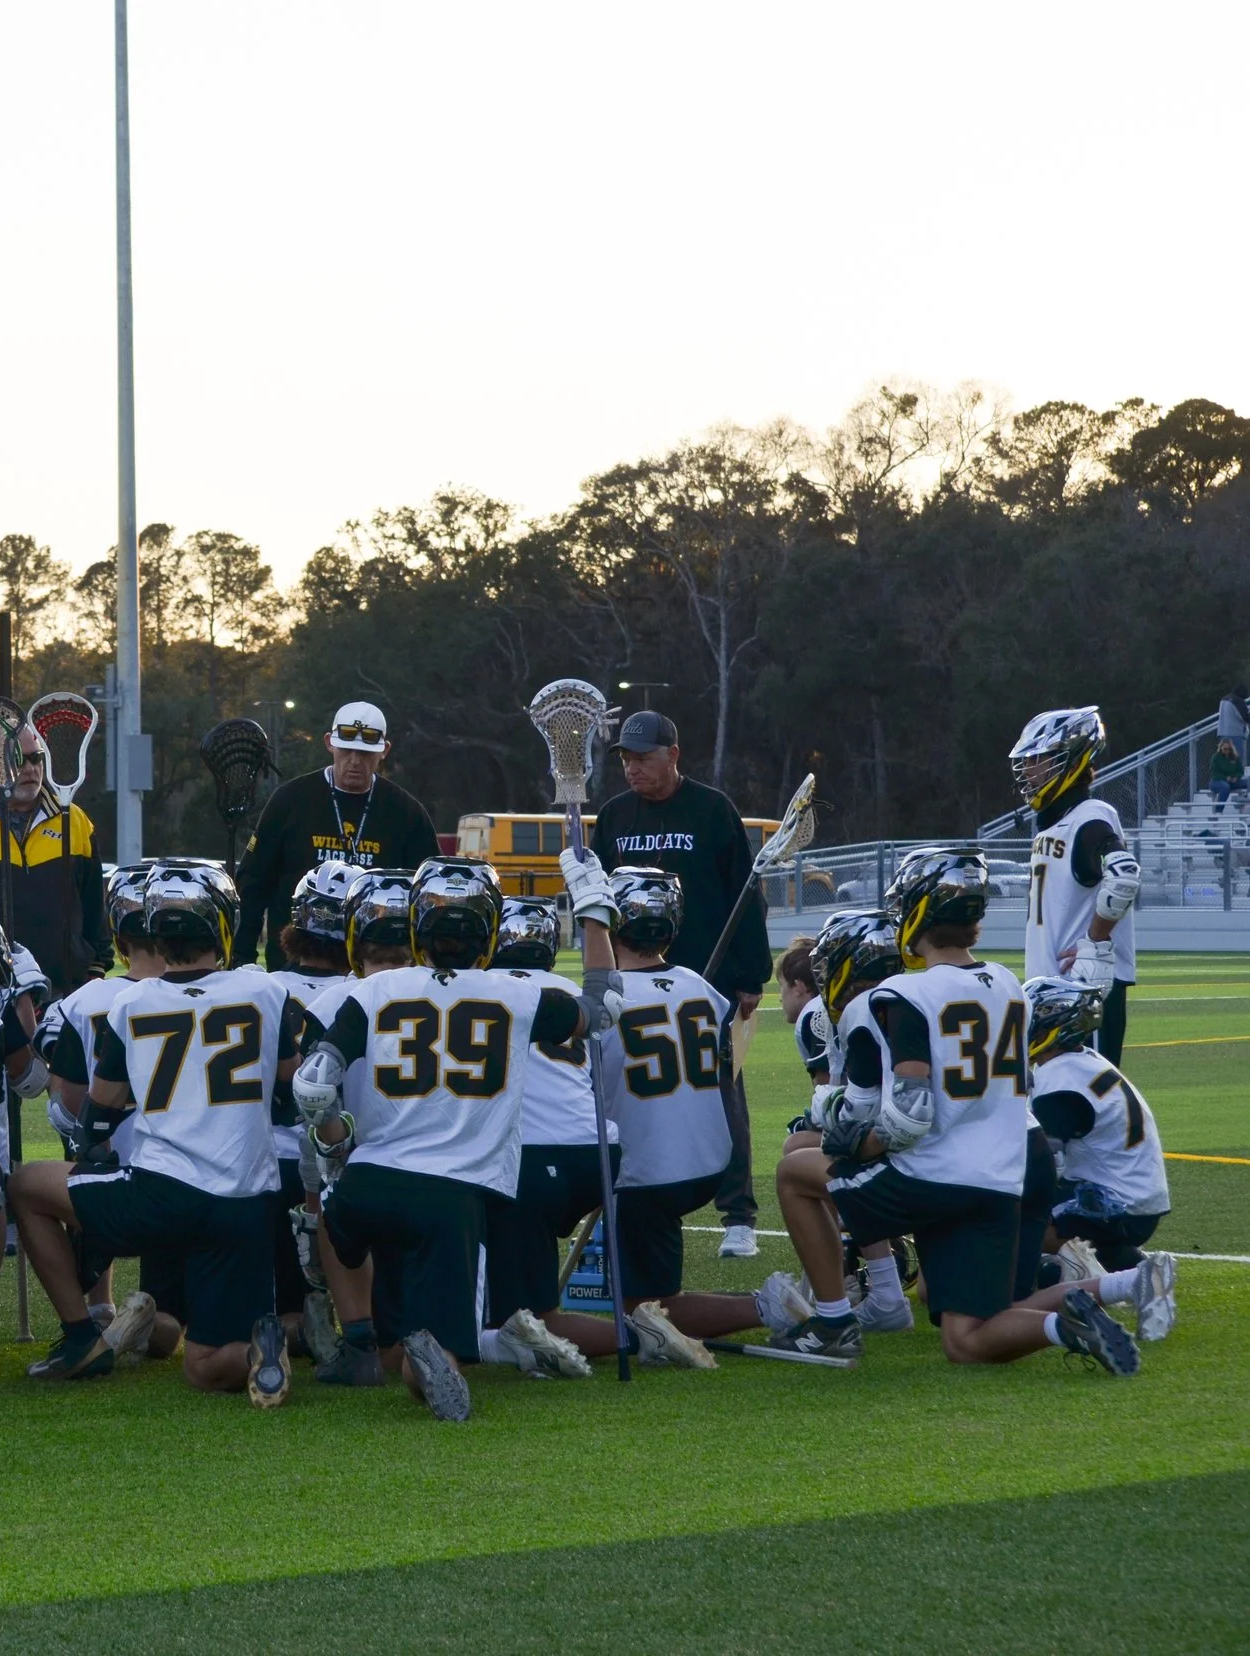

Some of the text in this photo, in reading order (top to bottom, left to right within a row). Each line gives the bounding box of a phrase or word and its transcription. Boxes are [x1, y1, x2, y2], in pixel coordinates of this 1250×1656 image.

[616, 833, 694, 852] WILDCATS
[129, 1000, 264, 1114] 72
[374, 998, 514, 1100] 39
[618, 998, 721, 1100] 56
[938, 999, 1028, 1101] 34
